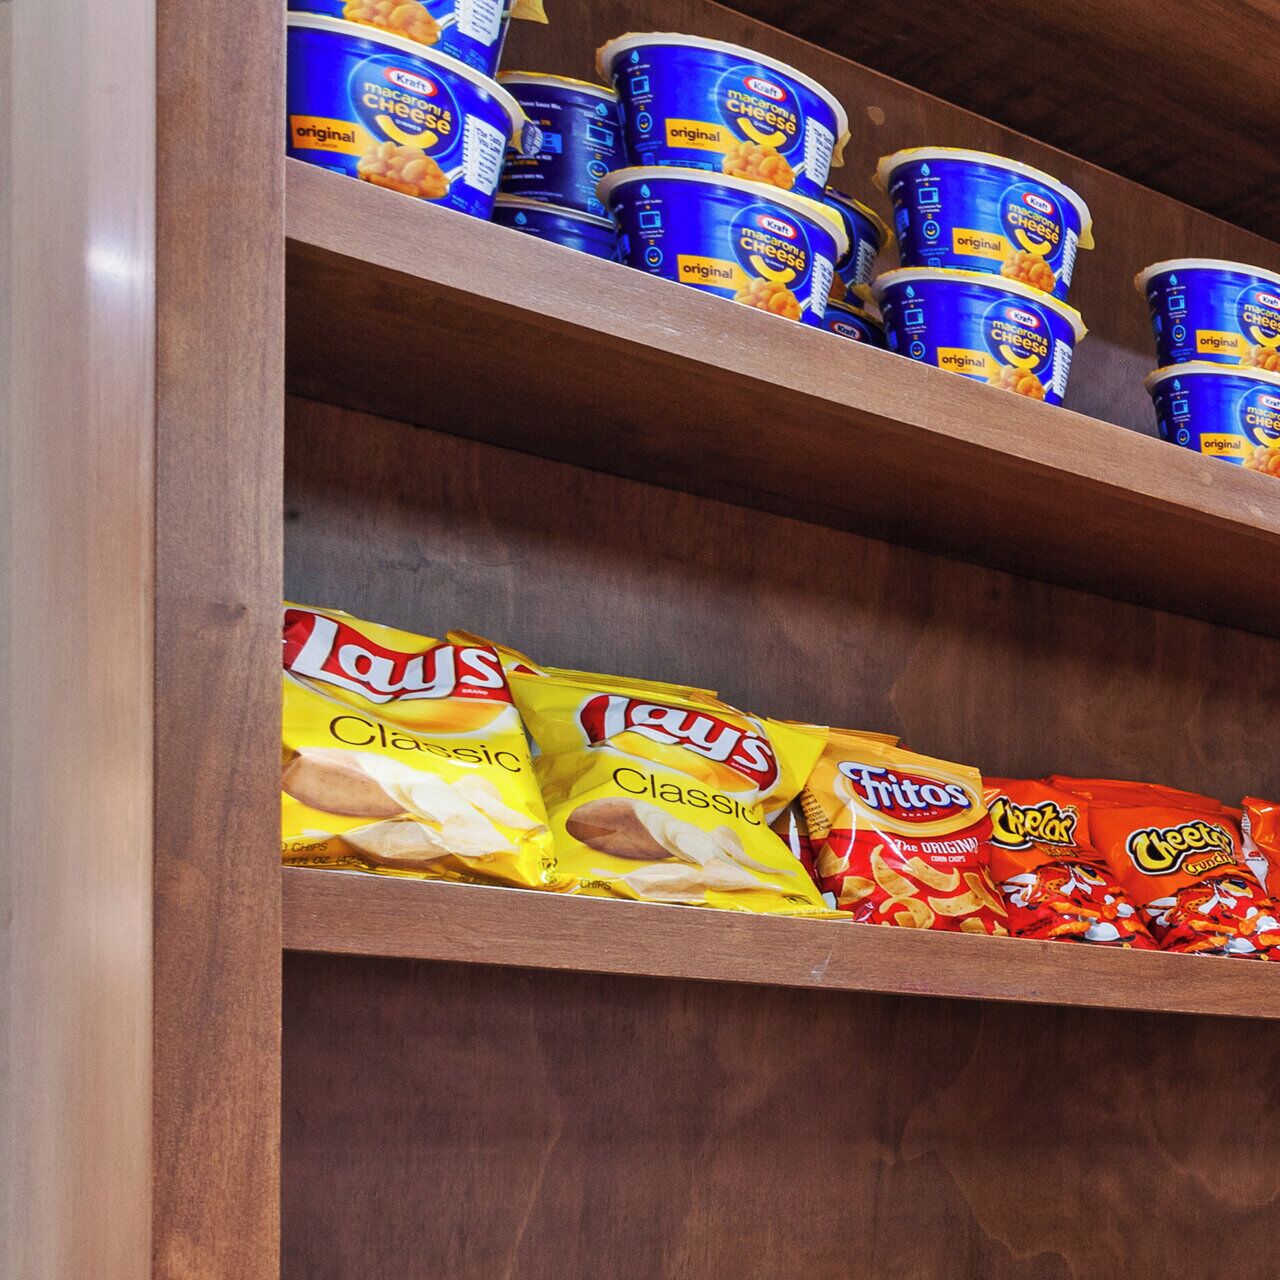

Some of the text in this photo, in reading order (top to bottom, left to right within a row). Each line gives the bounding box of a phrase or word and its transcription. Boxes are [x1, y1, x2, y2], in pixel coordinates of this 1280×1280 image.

[396, 72, 427, 93] Kraft
[753, 80, 779, 97] Kraft
[363, 82, 452, 121] macaroni &
[728, 89, 797, 123] macaroni &
[296, 125, 356, 143] original
[670, 127, 721, 146] original
[1029, 196, 1049, 211] Kraft
[1008, 203, 1053, 226] macaroni
[767, 218, 791, 236] Kraft
[741, 227, 806, 260] macaroni &
[957, 235, 1001, 253] original
[683, 263, 734, 282] original
[1262, 295, 1280, 308] Kraft
[1013, 311, 1034, 325] Kraft
[836, 324, 857, 339] Kraft
[992, 318, 1041, 340] macaroni
[1199, 334, 1239, 350] original
[941, 354, 987, 372] original
[1203, 437, 1242, 452] original
[462, 688, 489, 697] BRAND
[329, 716, 522, 774] Classic
[838, 760, 972, 809] Fritos
[612, 766, 762, 827] Classic
[989, 799, 1073, 843] Cheetos
[291, 842, 328, 852] CHIPS
